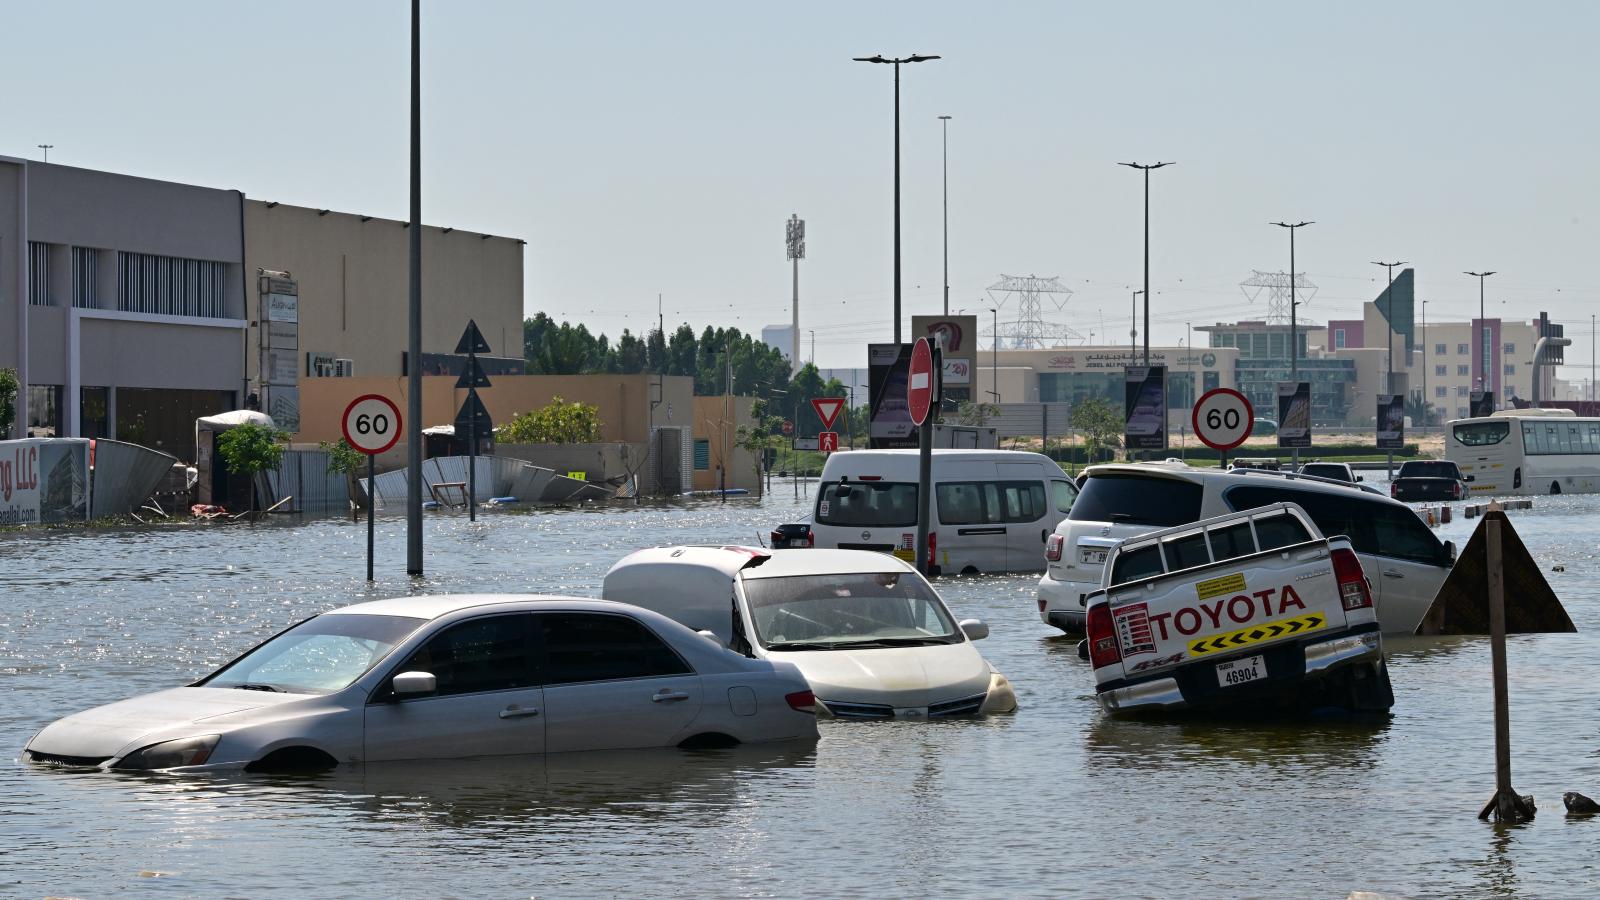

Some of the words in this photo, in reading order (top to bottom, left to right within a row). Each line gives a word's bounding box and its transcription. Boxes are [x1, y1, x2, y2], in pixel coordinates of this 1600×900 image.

[356, 414, 388, 434] 60
[1207, 408, 1239, 429] 60
[16, 446, 37, 490] LLC
[1150, 584, 1306, 640] TOYOTA
[1251, 657, 1258, 665] Z
[1226, 667, 1258, 685] 46904
